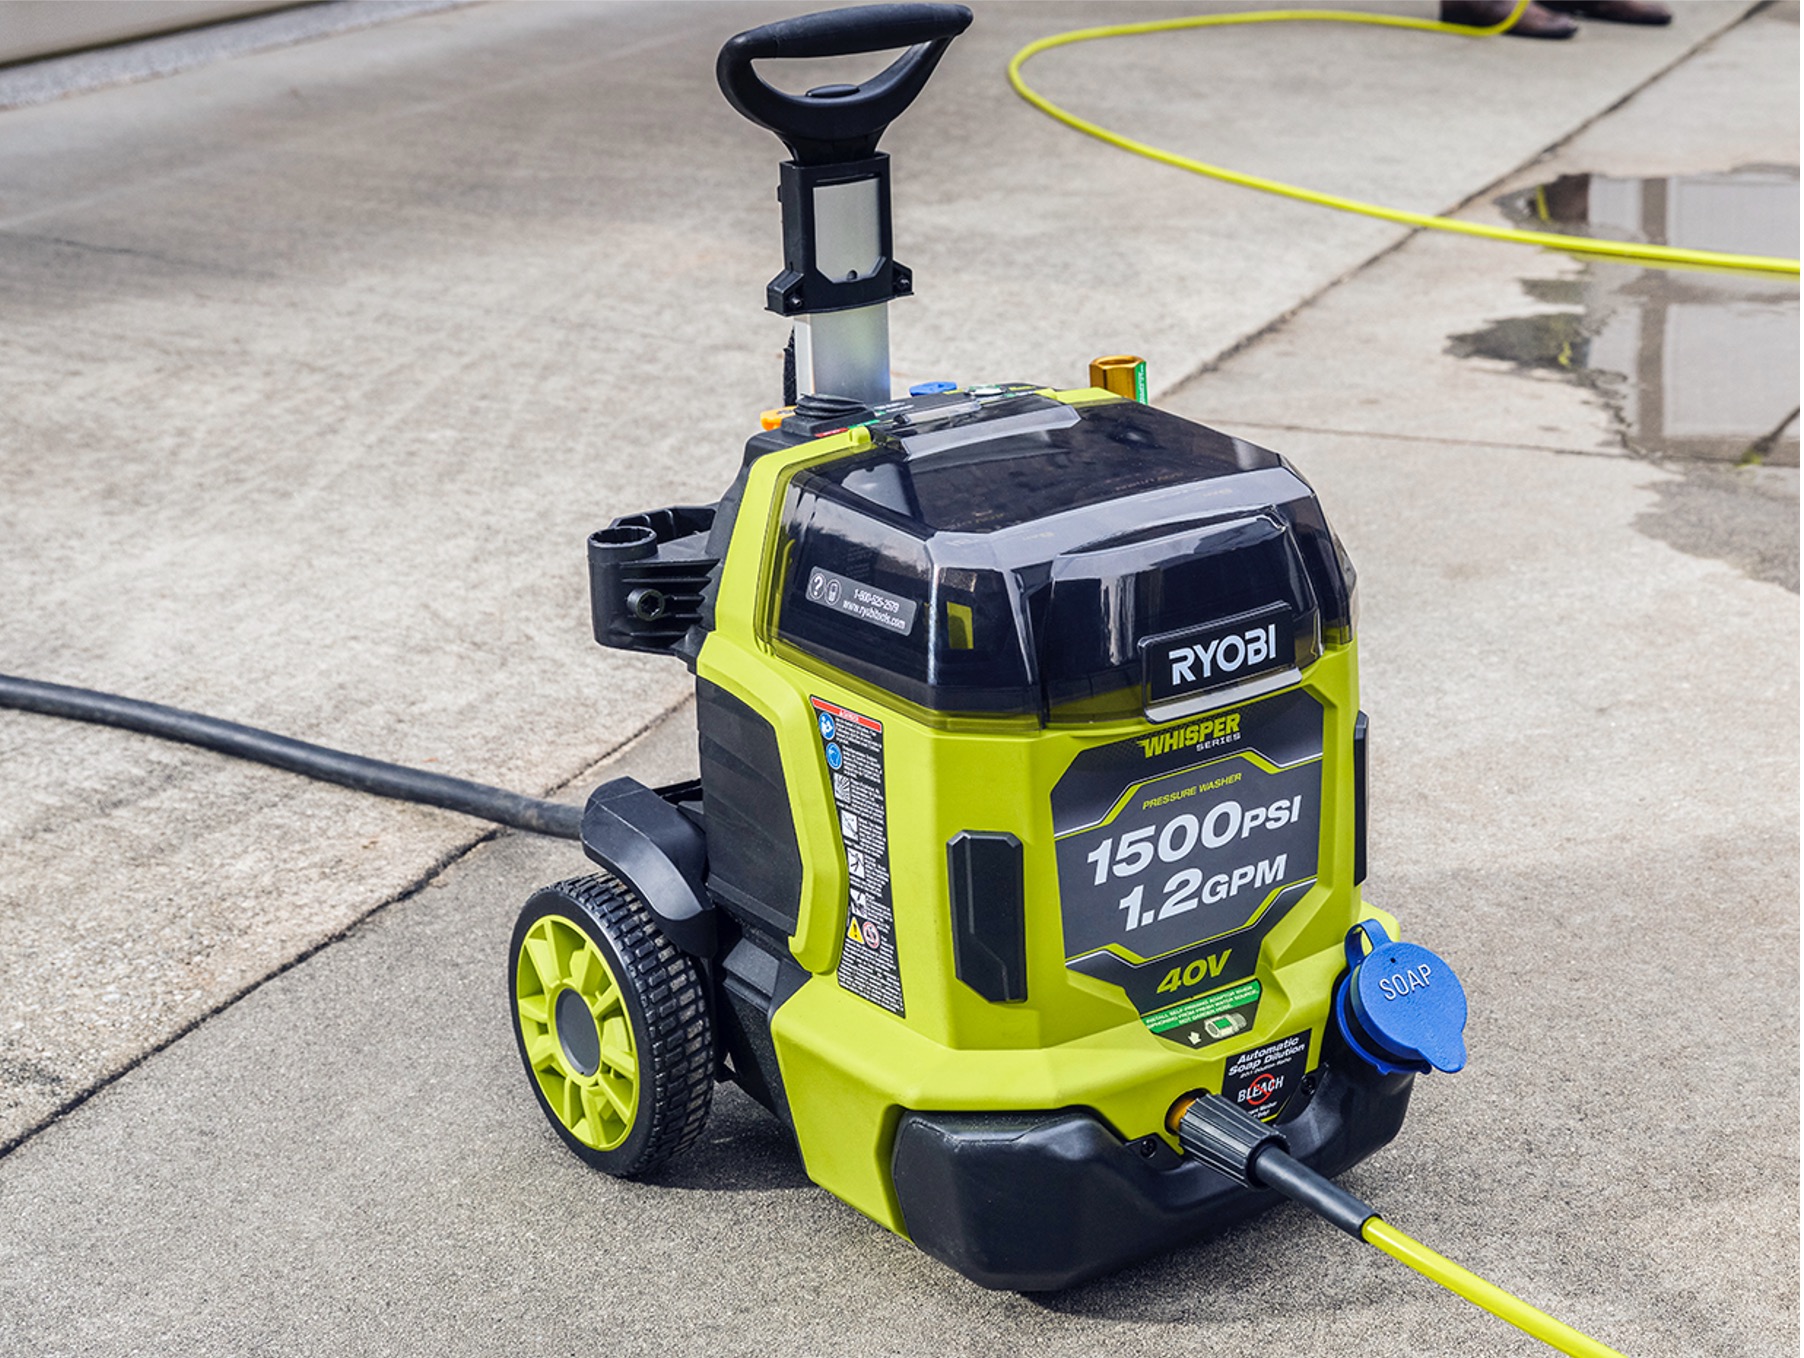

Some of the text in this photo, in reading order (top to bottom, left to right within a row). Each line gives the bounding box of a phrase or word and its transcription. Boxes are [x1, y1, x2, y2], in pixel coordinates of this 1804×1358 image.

[1168, 623, 1277, 686] RYOBI
[1136, 712, 1242, 759] WHISPER
[1196, 732, 1242, 752] SERIES
[1142, 772, 1243, 810] PRESSURE WASHER
[1156, 948, 1233, 994] 40V
[1379, 963, 1432, 1001] SOAP
[1228, 1043, 1305, 1076] Soap Dilution
[1236, 1037, 1300, 1065] Automatic
[1236, 1075, 1285, 1103] BLEACH
